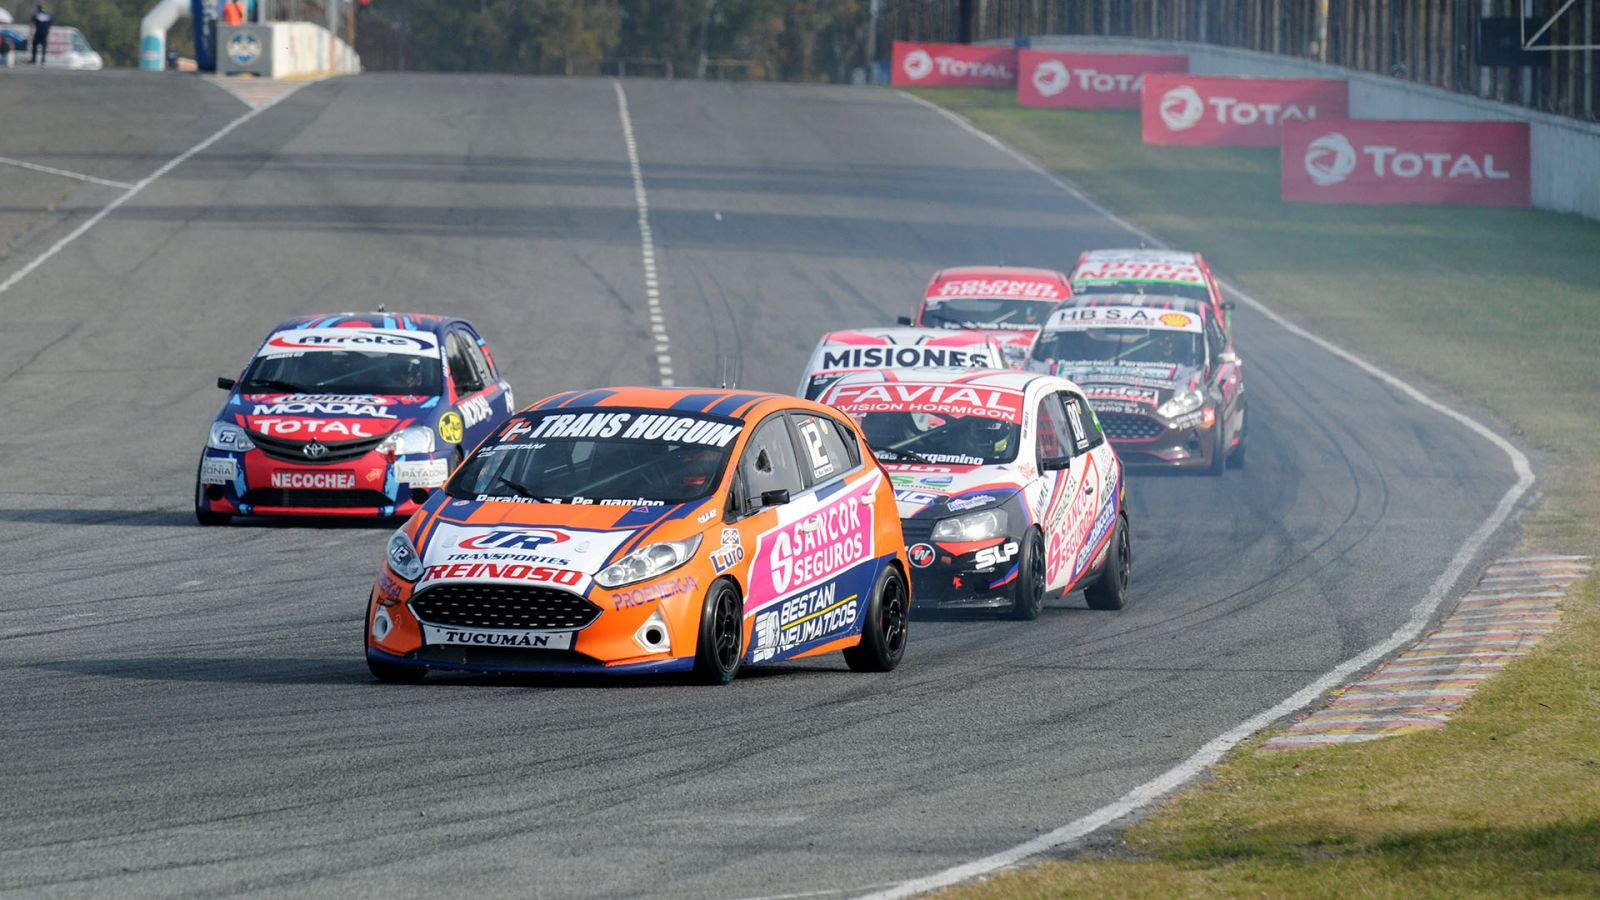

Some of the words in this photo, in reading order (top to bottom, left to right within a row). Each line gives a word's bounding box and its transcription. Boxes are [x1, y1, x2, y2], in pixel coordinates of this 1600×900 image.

[934, 57, 1013, 79] TOTAL
[1364, 146, 1511, 179] TOTAL
[1060, 309, 1096, 320] HB
[1106, 309, 1155, 320] S.A.
[823, 348, 988, 369] MISIONES
[826, 385, 1016, 411] FAVIAL
[253, 403, 397, 419] MONDIAL
[909, 403, 1016, 421] HORMIGON
[220, 431, 236, 442] 75
[254, 419, 372, 437] TOTAL
[529, 413, 628, 440] TRANS
[623, 413, 743, 448] HUGUIN
[800, 422, 829, 468] 12
[271, 472, 356, 488] NECOCHEA
[793, 496, 861, 556] SANCOR
[481, 531, 556, 550] TR
[447, 552, 571, 566] TRANSPORTES
[793, 533, 863, 586] SEGUROS
[975, 541, 1019, 570] SLP
[423, 563, 584, 587] REINOSO
[781, 582, 836, 625] BESTANI
[445, 631, 550, 647] TUCUMÁN
